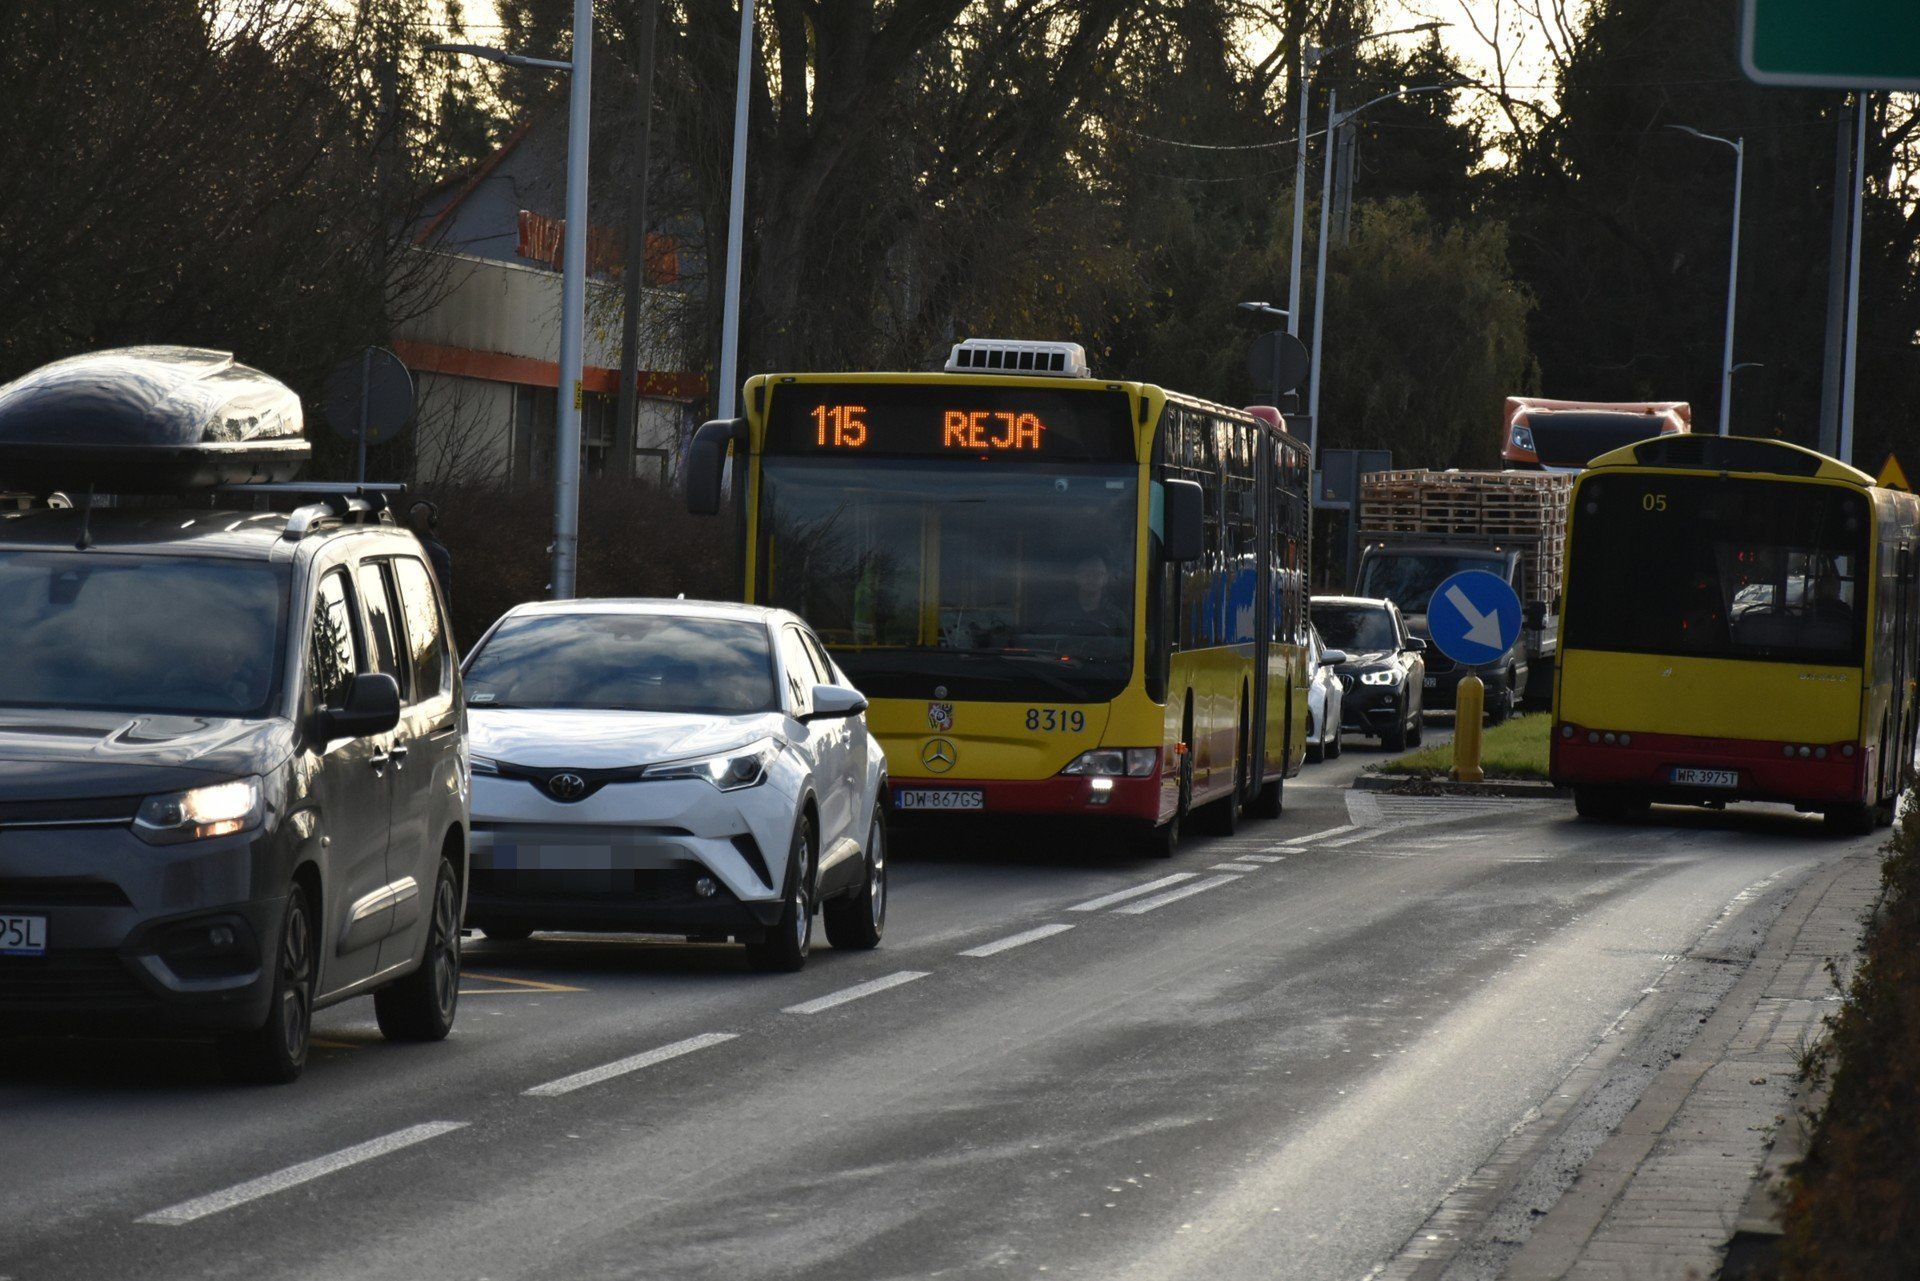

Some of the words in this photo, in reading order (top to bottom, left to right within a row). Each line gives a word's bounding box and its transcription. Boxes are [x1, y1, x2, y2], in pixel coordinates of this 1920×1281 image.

[811, 405, 867, 446] 115
[944, 411, 1039, 449] REJA
[1643, 493, 1667, 511] 05
[1025, 708, 1085, 732] 8319
[1678, 769, 1695, 782] WR
[904, 792, 927, 807] DW
[931, 792, 981, 807] 867GS
